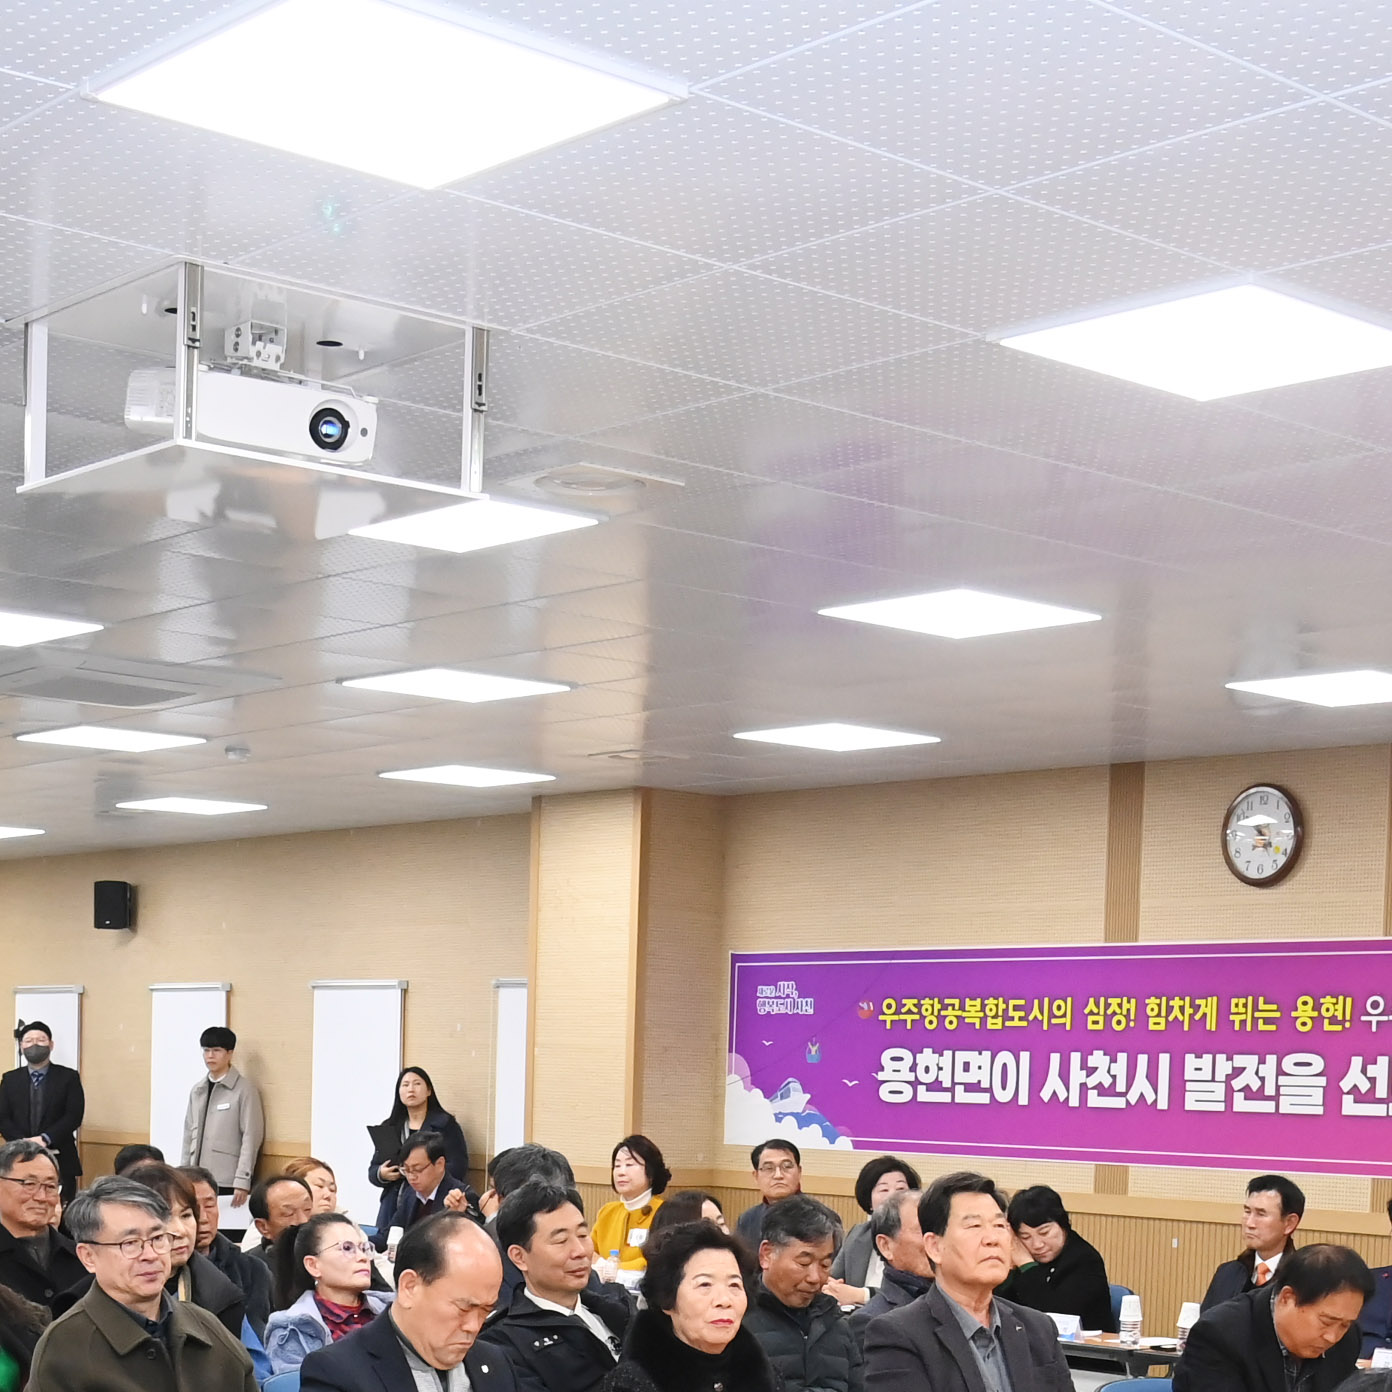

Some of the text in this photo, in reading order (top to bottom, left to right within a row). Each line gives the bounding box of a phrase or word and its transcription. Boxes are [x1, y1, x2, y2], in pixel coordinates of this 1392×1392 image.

[879, 997, 1072, 1031] 우주항공복합도시의
[1084, 996, 1137, 1031] 심장!
[1146, 996, 1219, 1032] 힘차게
[1229, 995, 1281, 1032] 뛰는
[1291, 995, 1353, 1034] 용현!
[877, 1047, 1031, 1107] 용현면이
[1039, 1050, 1171, 1110] 사천시
[1184, 1053, 1327, 1115] 발전을
